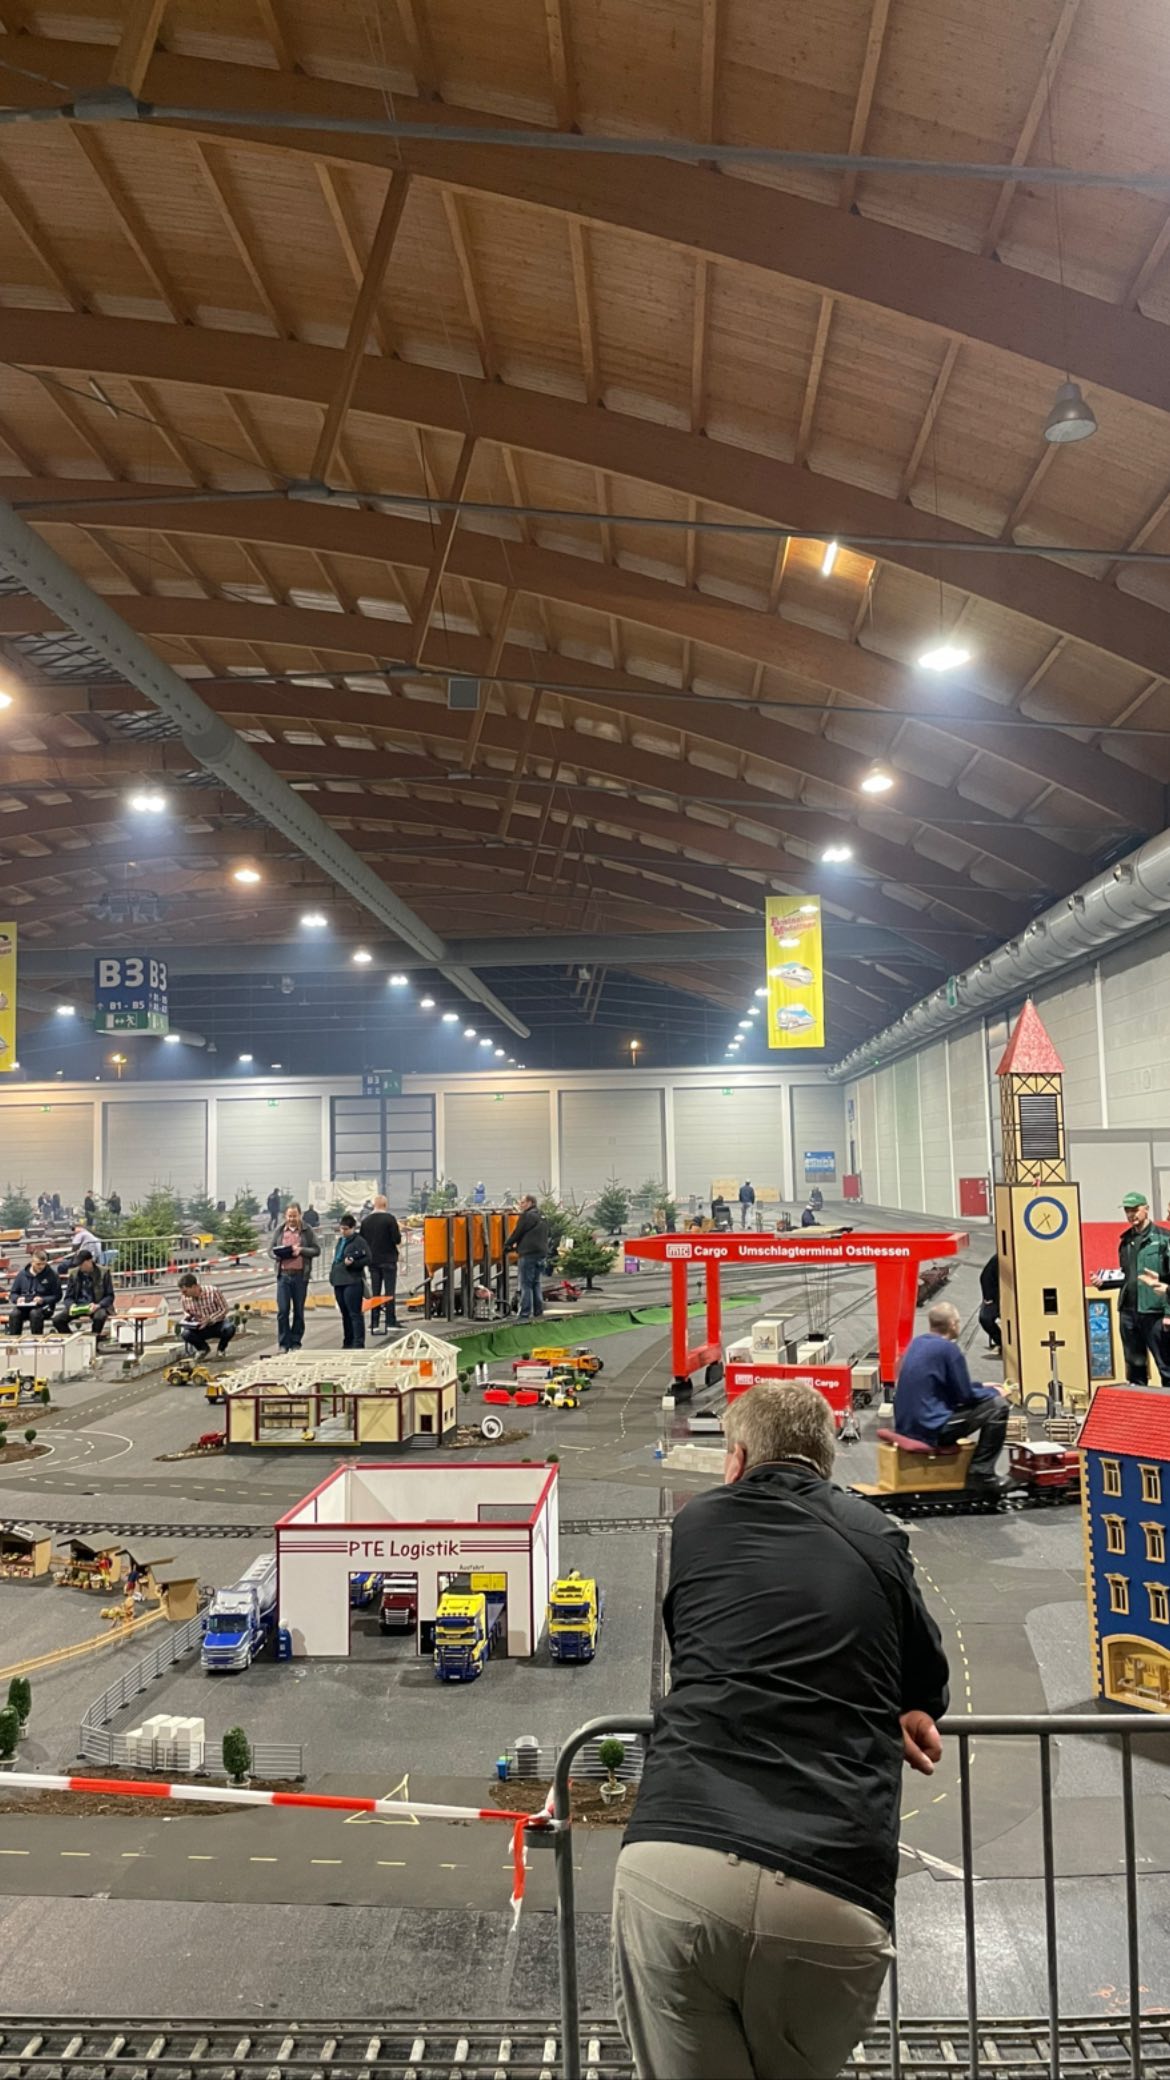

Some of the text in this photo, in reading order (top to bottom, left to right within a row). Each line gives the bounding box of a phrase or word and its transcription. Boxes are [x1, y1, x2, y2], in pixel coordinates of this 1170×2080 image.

[99, 958, 144, 988] B3
[149, 960, 167, 991] B3
[109, 1001, 122, 1010] B1
[694, 1246, 728, 1258] Cargo
[739, 1245, 843, 1258] Umschlagterminal
[846, 1245, 910, 1256] Osthessen
[815, 1379, 840, 1389] Cargo
[349, 1540, 459, 1560] PTE Logistik
